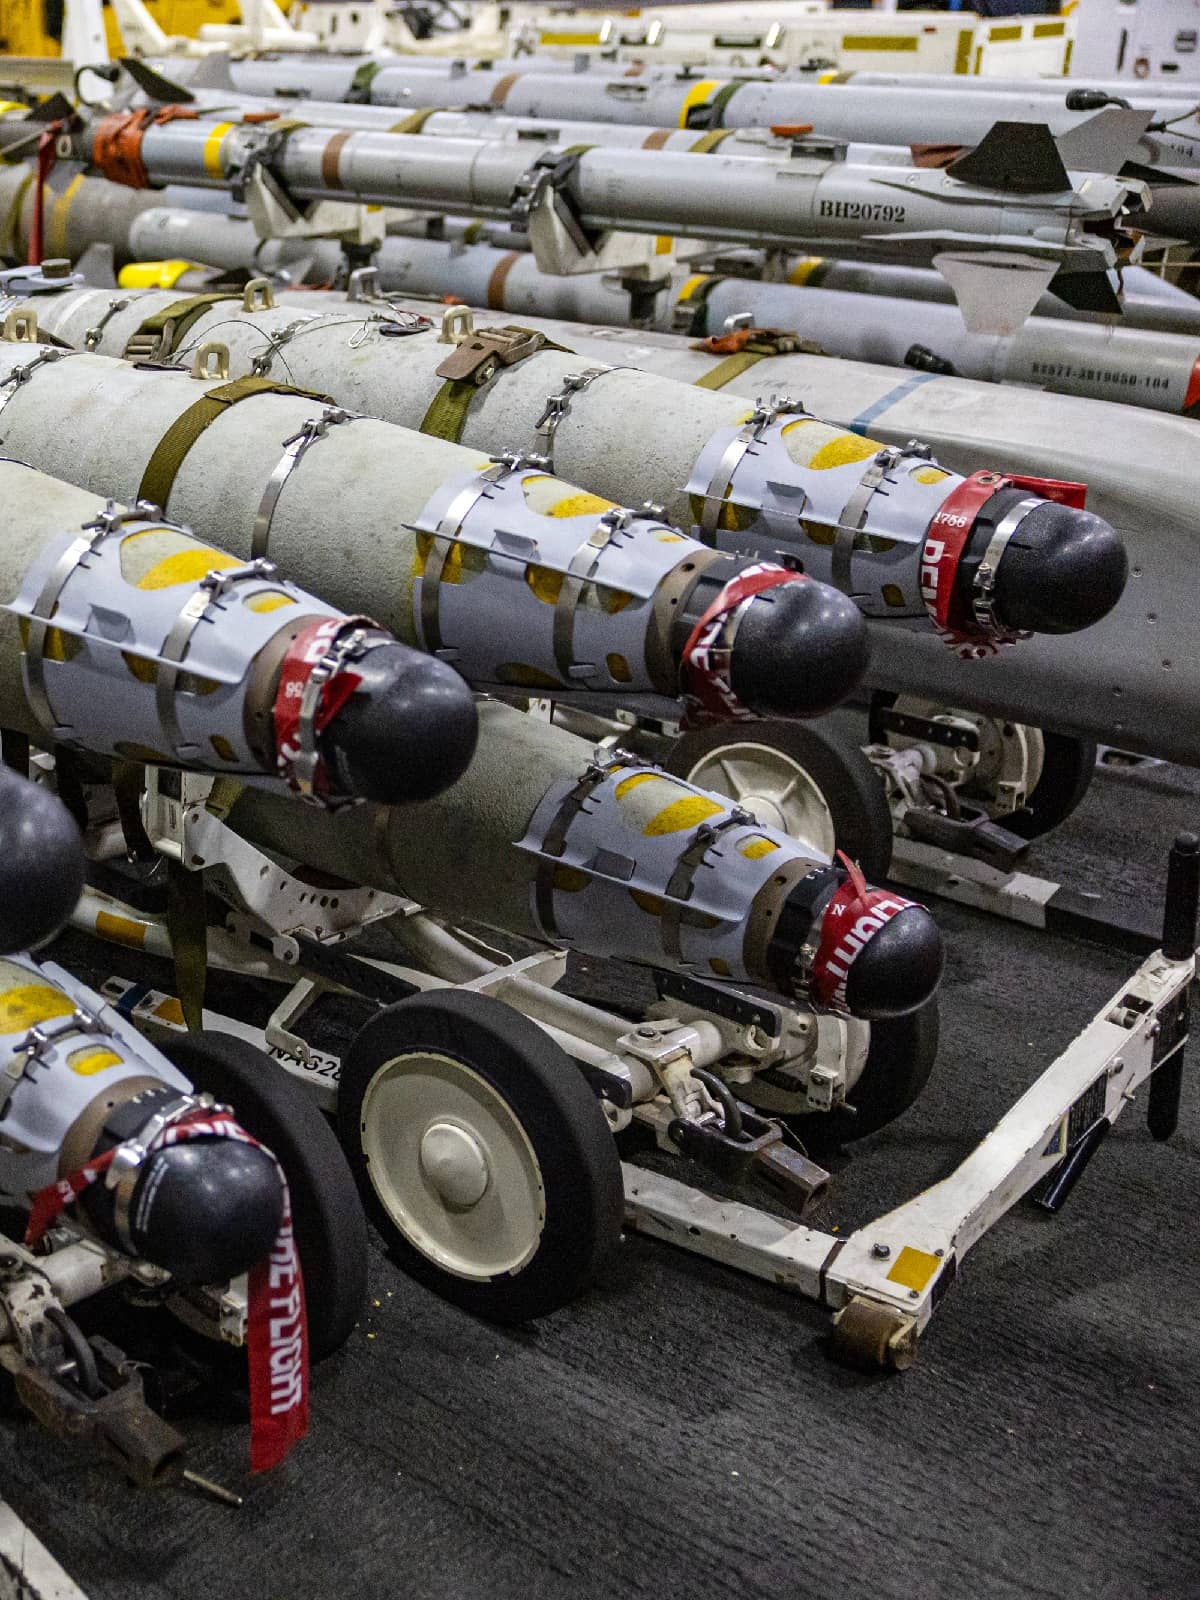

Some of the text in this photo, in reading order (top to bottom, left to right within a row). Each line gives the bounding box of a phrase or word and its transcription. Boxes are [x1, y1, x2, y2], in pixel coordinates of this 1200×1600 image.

[820, 200, 906, 223] BH20792
[933, 511, 969, 528] 1756
[269, 1287, 303, 1416] FLIGHT
